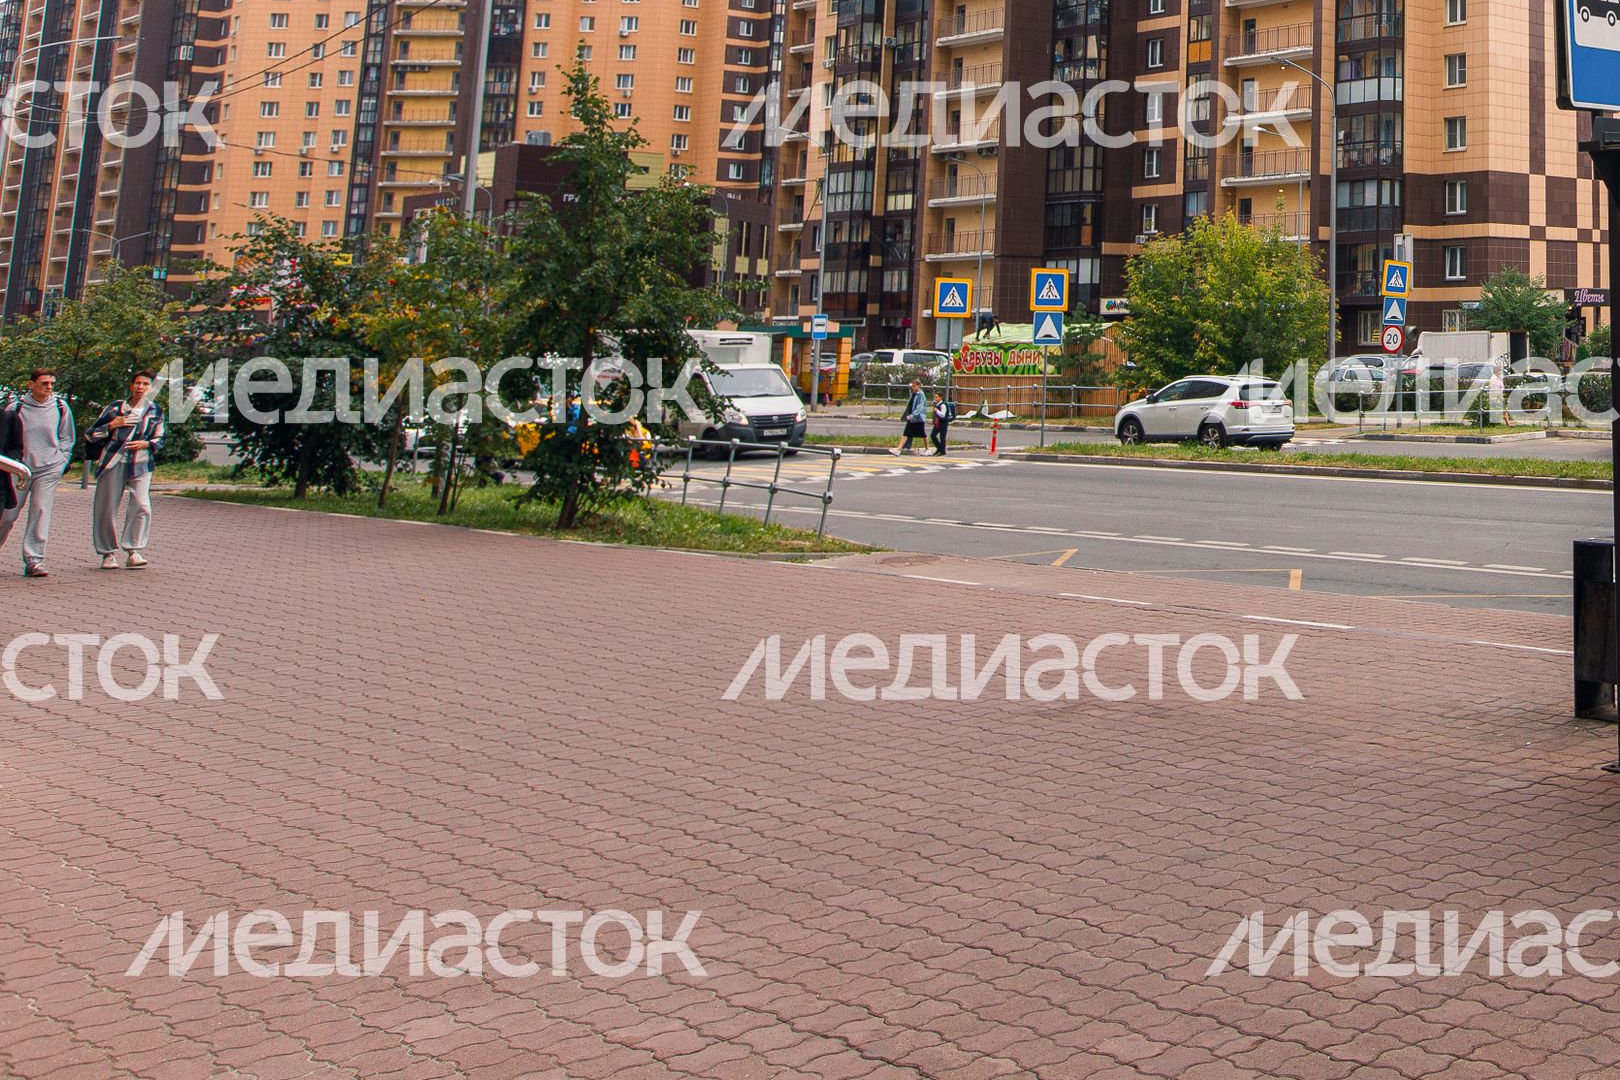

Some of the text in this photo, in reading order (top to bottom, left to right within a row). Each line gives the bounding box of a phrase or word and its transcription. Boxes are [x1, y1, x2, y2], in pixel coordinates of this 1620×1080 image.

[1574, 287, 1605, 307] Цветы
[1385, 333, 1399, 345] 20
[961, 348, 1041, 368] АРБУЗЫ ДЫНИ
